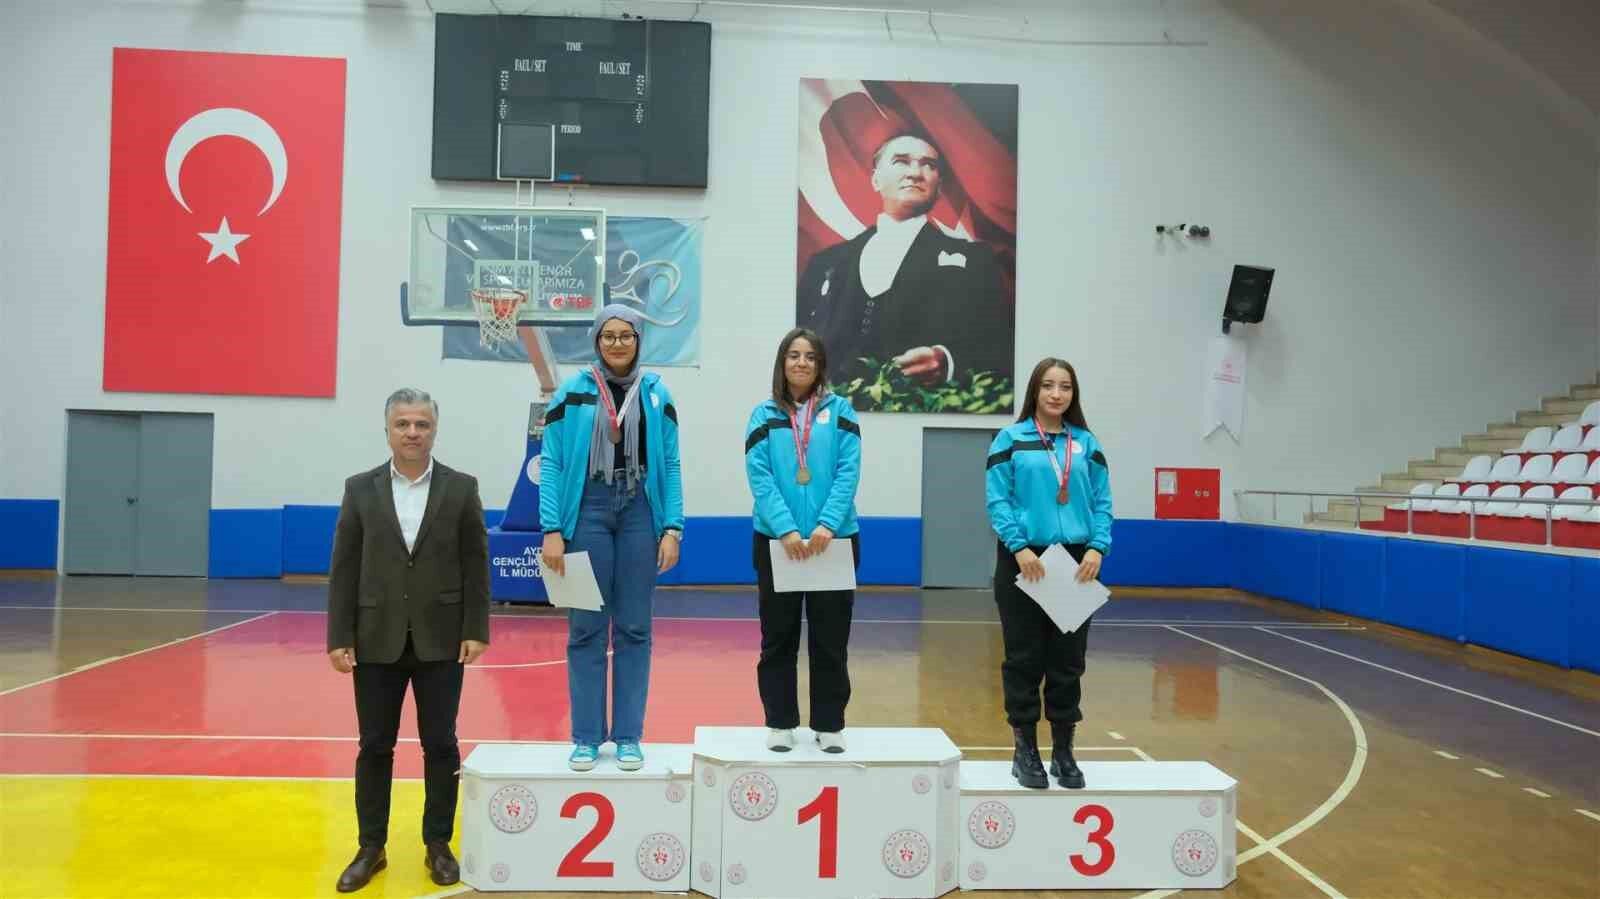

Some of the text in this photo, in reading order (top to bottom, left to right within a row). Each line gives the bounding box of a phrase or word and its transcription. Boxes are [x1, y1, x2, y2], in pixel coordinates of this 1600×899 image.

[514, 58, 547, 72] FAUL/SET
[599, 61, 631, 75] FAUL/SET
[523, 546, 544, 557] AYD
[511, 566, 543, 578] MÜDÜ
[556, 792, 615, 877] 2
[798, 786, 839, 879] 1
[1069, 804, 1116, 877] 3
